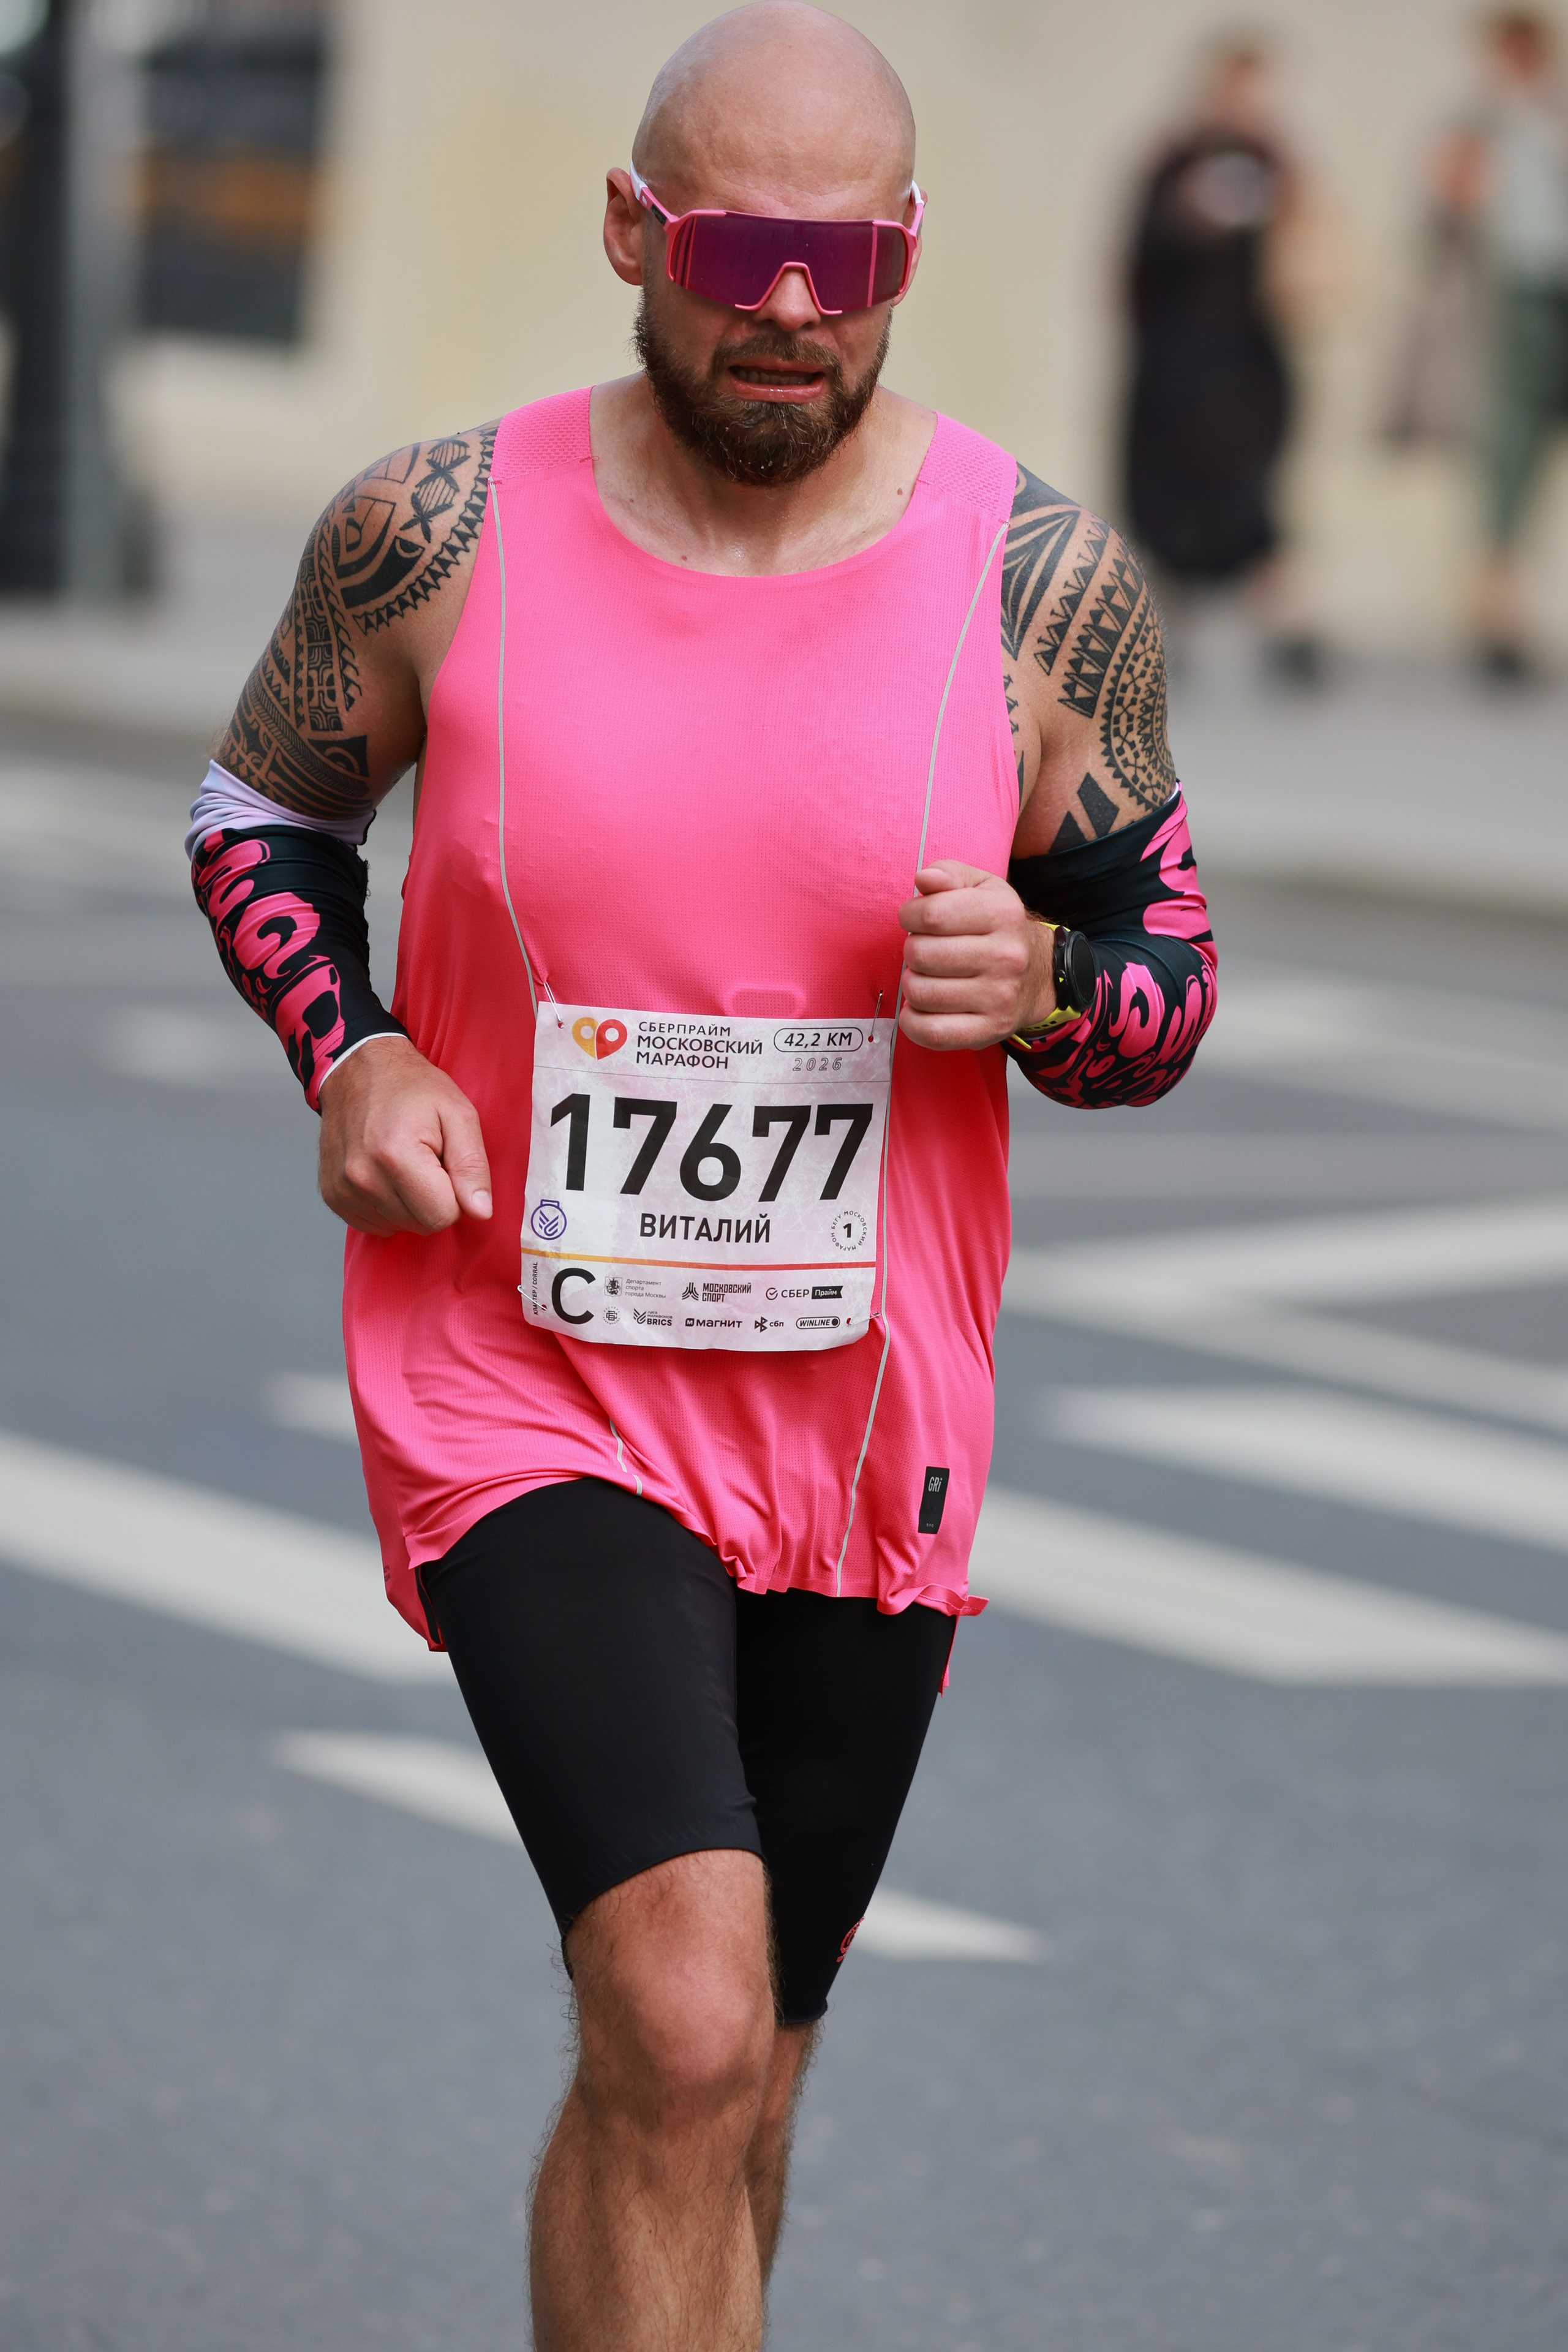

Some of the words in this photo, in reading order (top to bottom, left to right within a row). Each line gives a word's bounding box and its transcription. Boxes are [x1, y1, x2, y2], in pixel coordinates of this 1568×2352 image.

[639, 1022, 731, 1036] СБЕРПРАЙМ
[637, 1035, 763, 1055] МОСКОВСКИЙ
[784, 1033, 821, 1049] 42,2
[636, 1051, 729, 1069] МАРАФОН
[793, 1057, 842, 1071] 2026
[550, 1093, 873, 1202] 17677
[640, 1213, 771, 1243] ВИТАЛИЙ
[843, 1223, 851, 1238] 1
[703, 1283, 752, 1294] МОСКОВСКИЙ
[781, 1289, 809, 1298] СБЕР
[702, 1292, 725, 1302] СПОРТ
